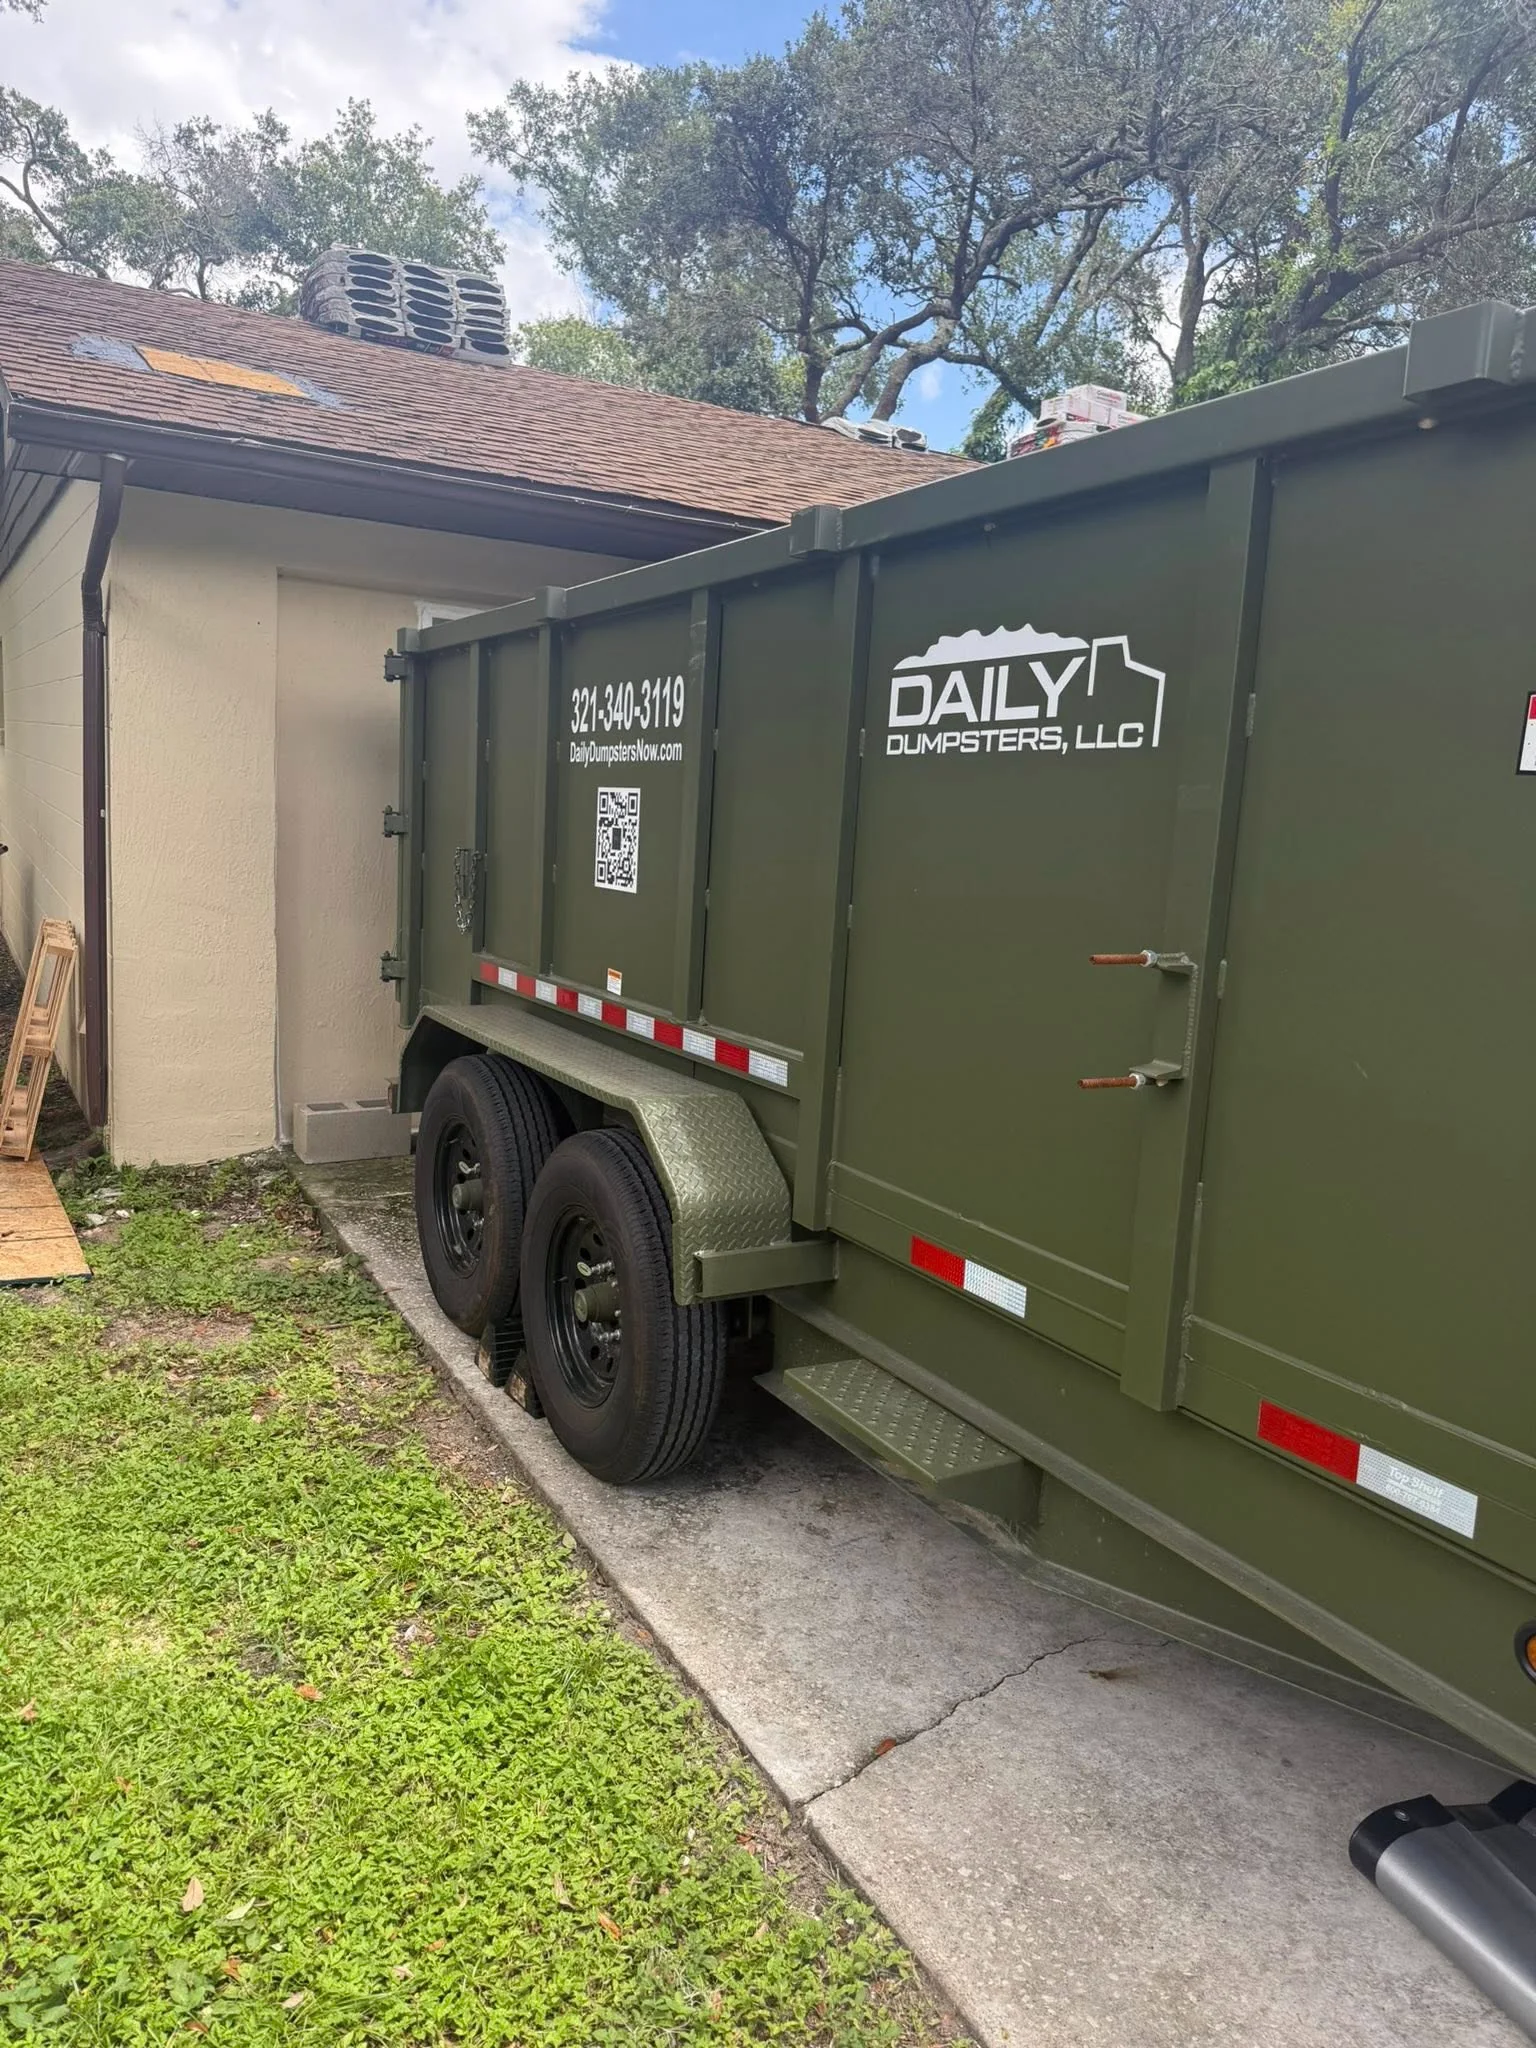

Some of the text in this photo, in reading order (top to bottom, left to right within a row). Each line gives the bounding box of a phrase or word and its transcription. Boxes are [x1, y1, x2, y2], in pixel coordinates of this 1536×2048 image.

[571, 675, 685, 733] 321-340-3119
[888, 656, 1087, 728] DAILY
[570, 738, 682, 768] DailyDumpstersNow.com
[886, 722, 1144, 756] DUMPSTERS, LLC
[1389, 1465, 1410, 1485] Top
